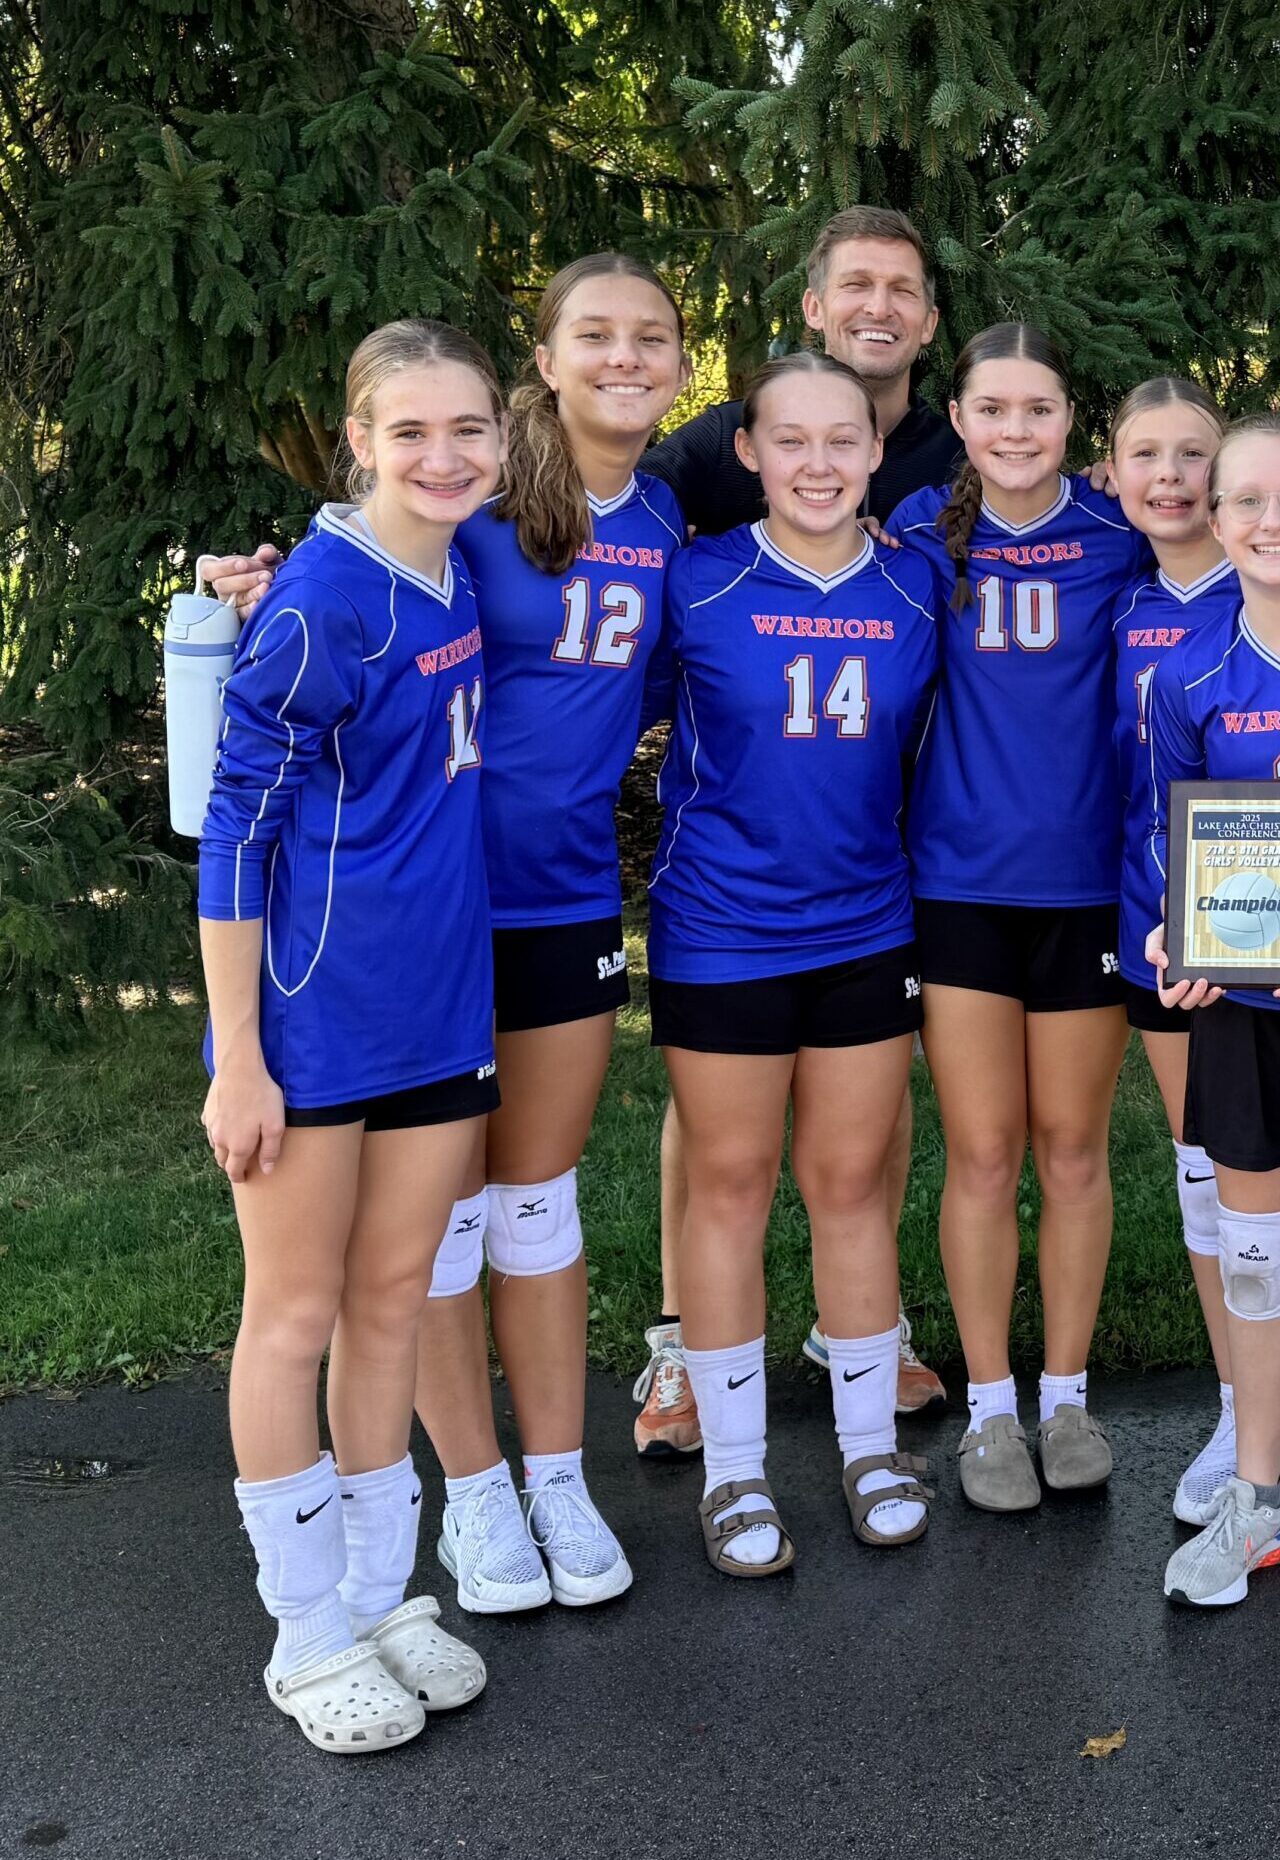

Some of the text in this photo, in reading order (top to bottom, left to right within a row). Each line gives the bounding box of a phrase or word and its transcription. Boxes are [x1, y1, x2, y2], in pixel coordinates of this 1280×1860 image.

[574, 542, 664, 569] RRIORS
[550, 576, 645, 668] 12
[975, 574, 1059, 652] 10
[751, 614, 895, 640] WARRIORS
[1127, 628, 1192, 647] WARR
[783, 654, 869, 738] 14
[1198, 822, 1221, 830] LAKE
[1223, 822, 1247, 830] AREA
[1240, 814, 1261, 822] 2025
[1206, 845, 1226, 855] 7TH
[1228, 846, 1237, 855] &
[1239, 845, 1260, 855] 8TH
[327, 1647, 366, 1668] crocs
